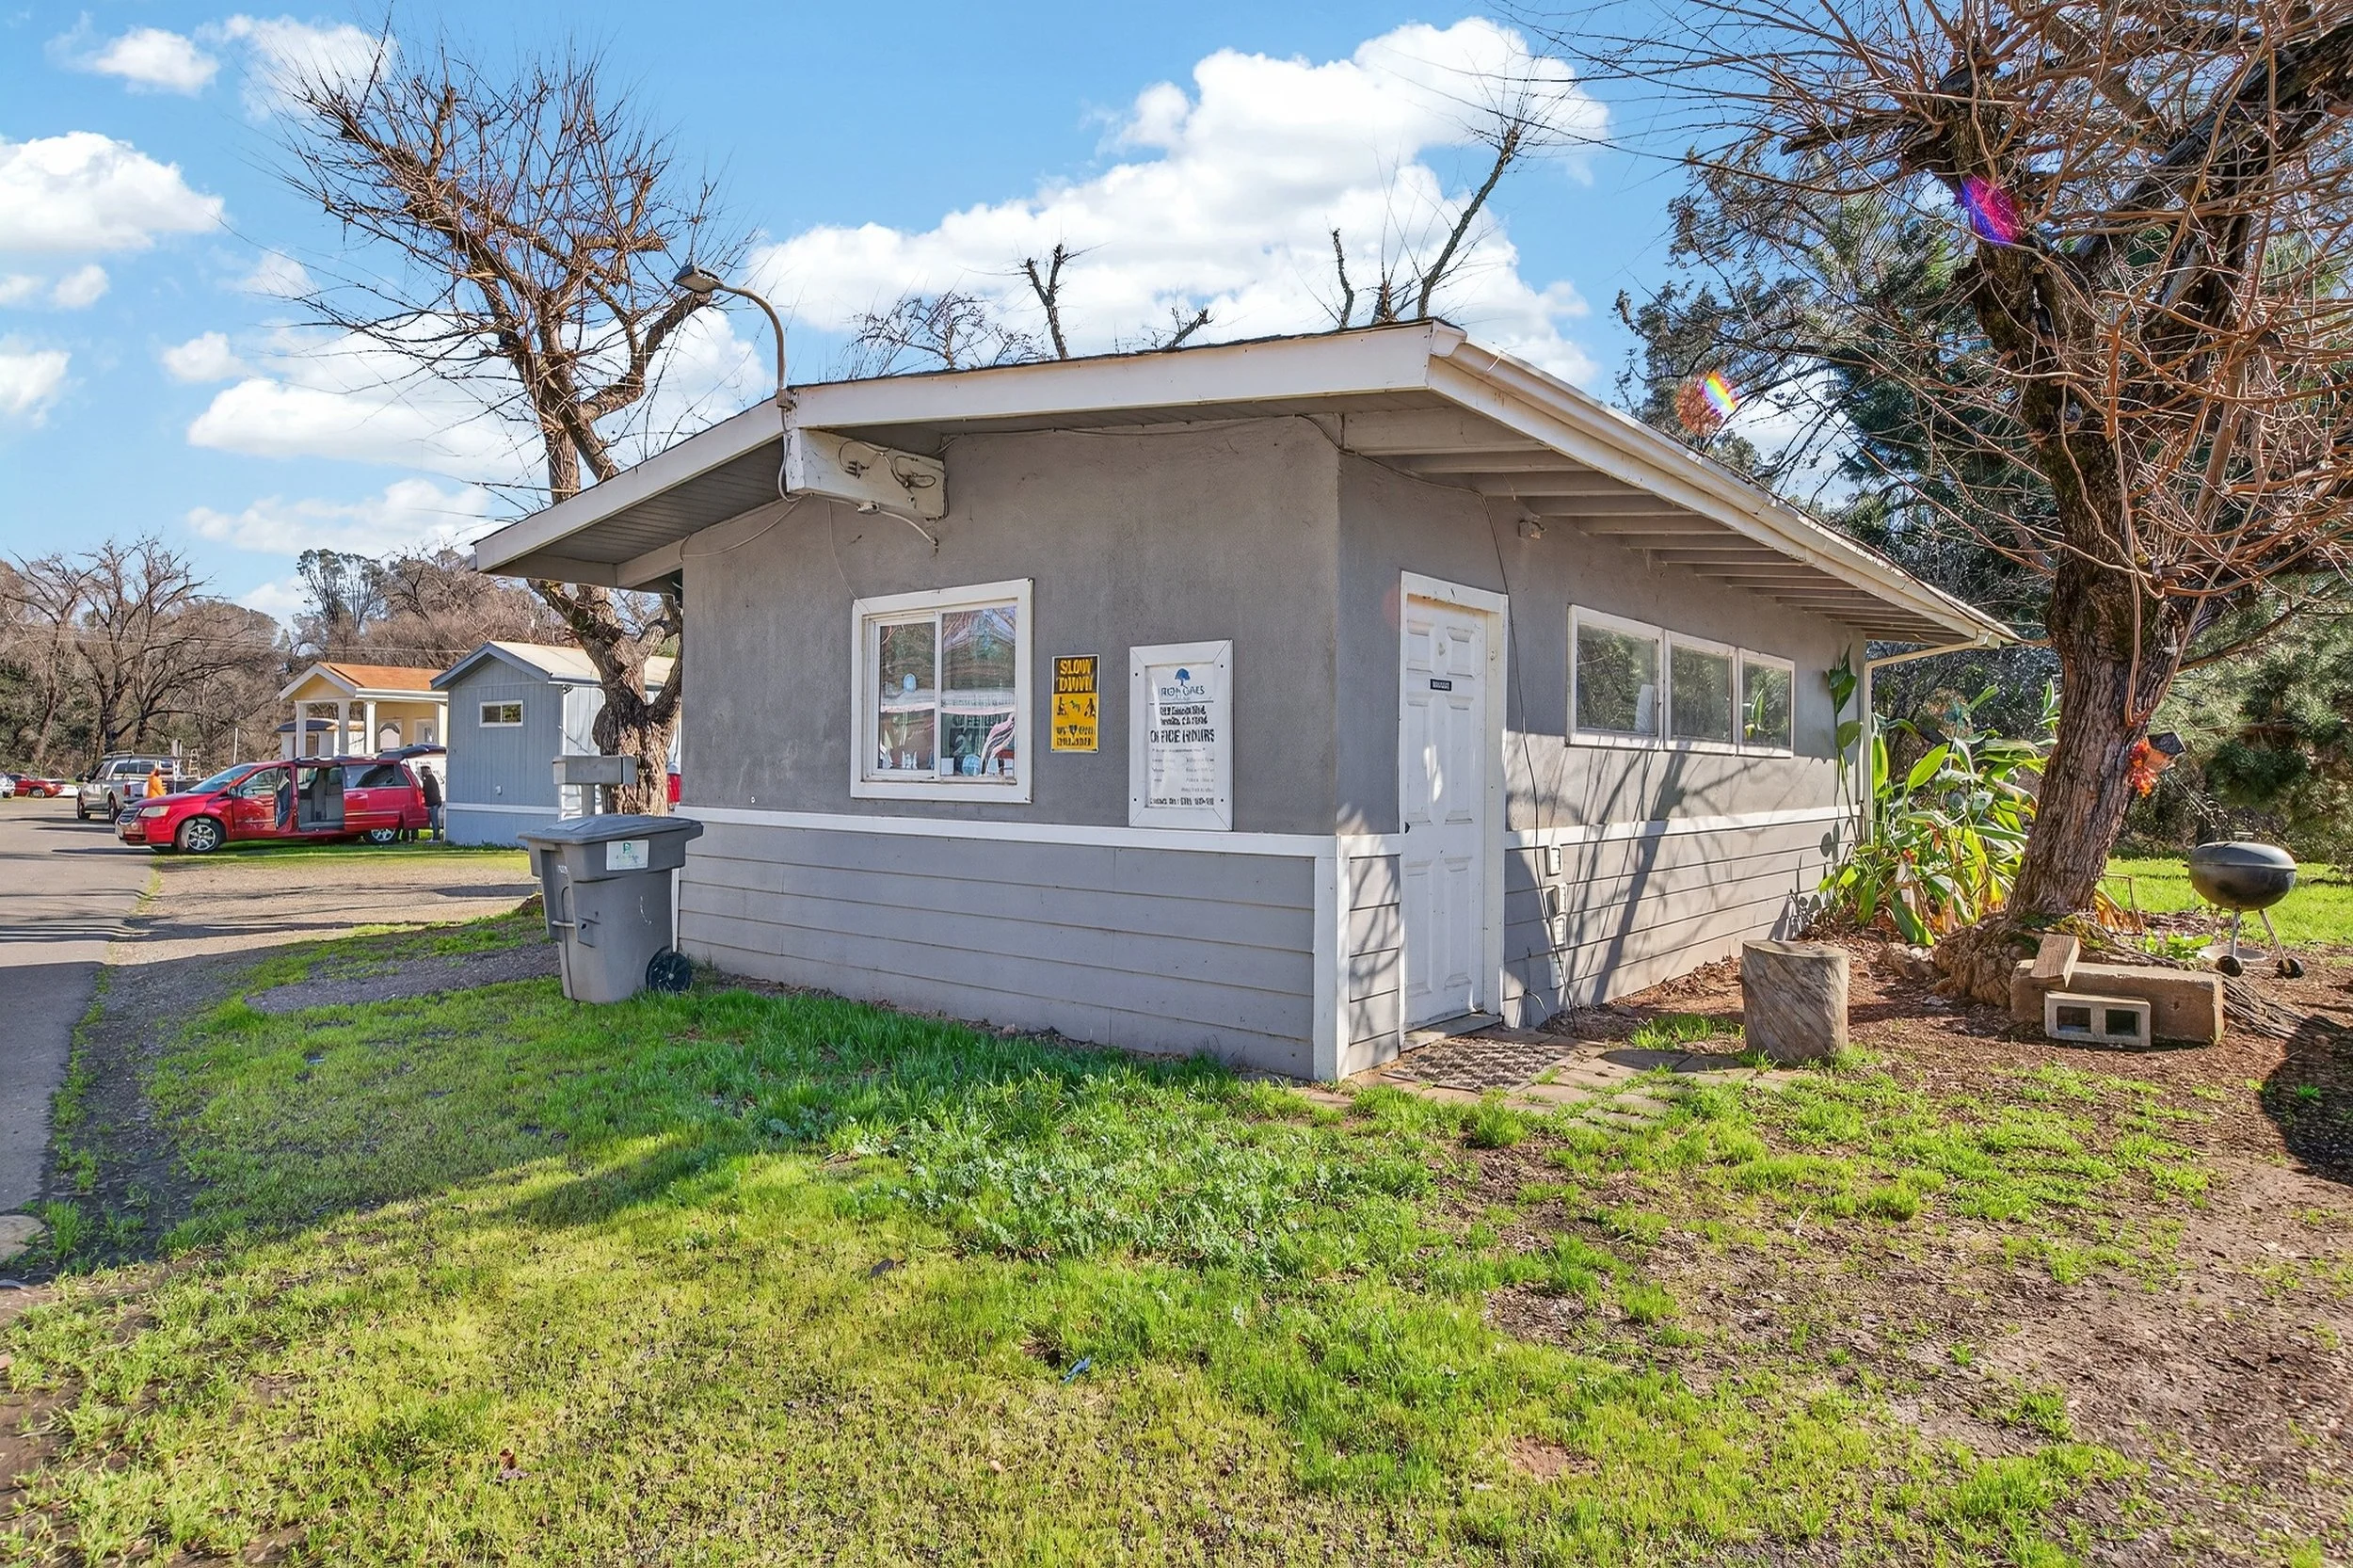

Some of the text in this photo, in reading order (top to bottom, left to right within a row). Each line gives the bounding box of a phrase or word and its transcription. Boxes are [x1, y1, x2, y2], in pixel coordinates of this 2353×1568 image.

[1059, 658, 1093, 675] SLOW
[1150, 728, 1215, 744] OFFICE HOURS
